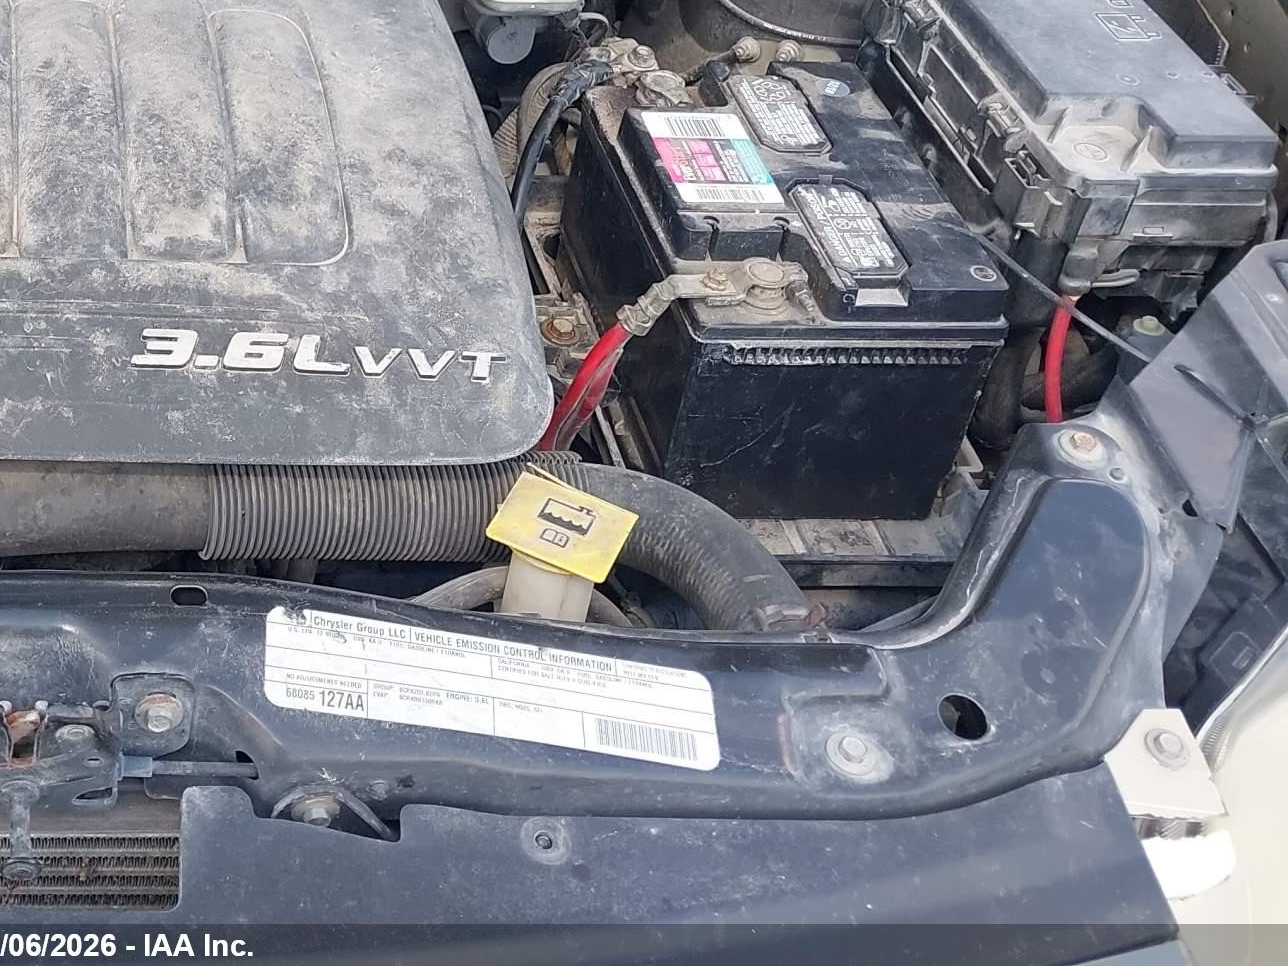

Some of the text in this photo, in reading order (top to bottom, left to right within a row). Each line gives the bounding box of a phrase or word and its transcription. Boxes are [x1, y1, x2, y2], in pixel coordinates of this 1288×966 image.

[129, 328, 508, 383] 3.6L VVT
[313, 616, 354, 632] Chrysler
[357, 622, 385, 638] Group
[388, 627, 406, 640] LLC
[414, 631, 453, 647] VEHICLE
[456, 638, 500, 655] EMISSION
[503, 646, 546, 662] CONTROL
[548, 652, 612, 673] INFORMATION
[286, 687, 365, 712] 68085 127AA
